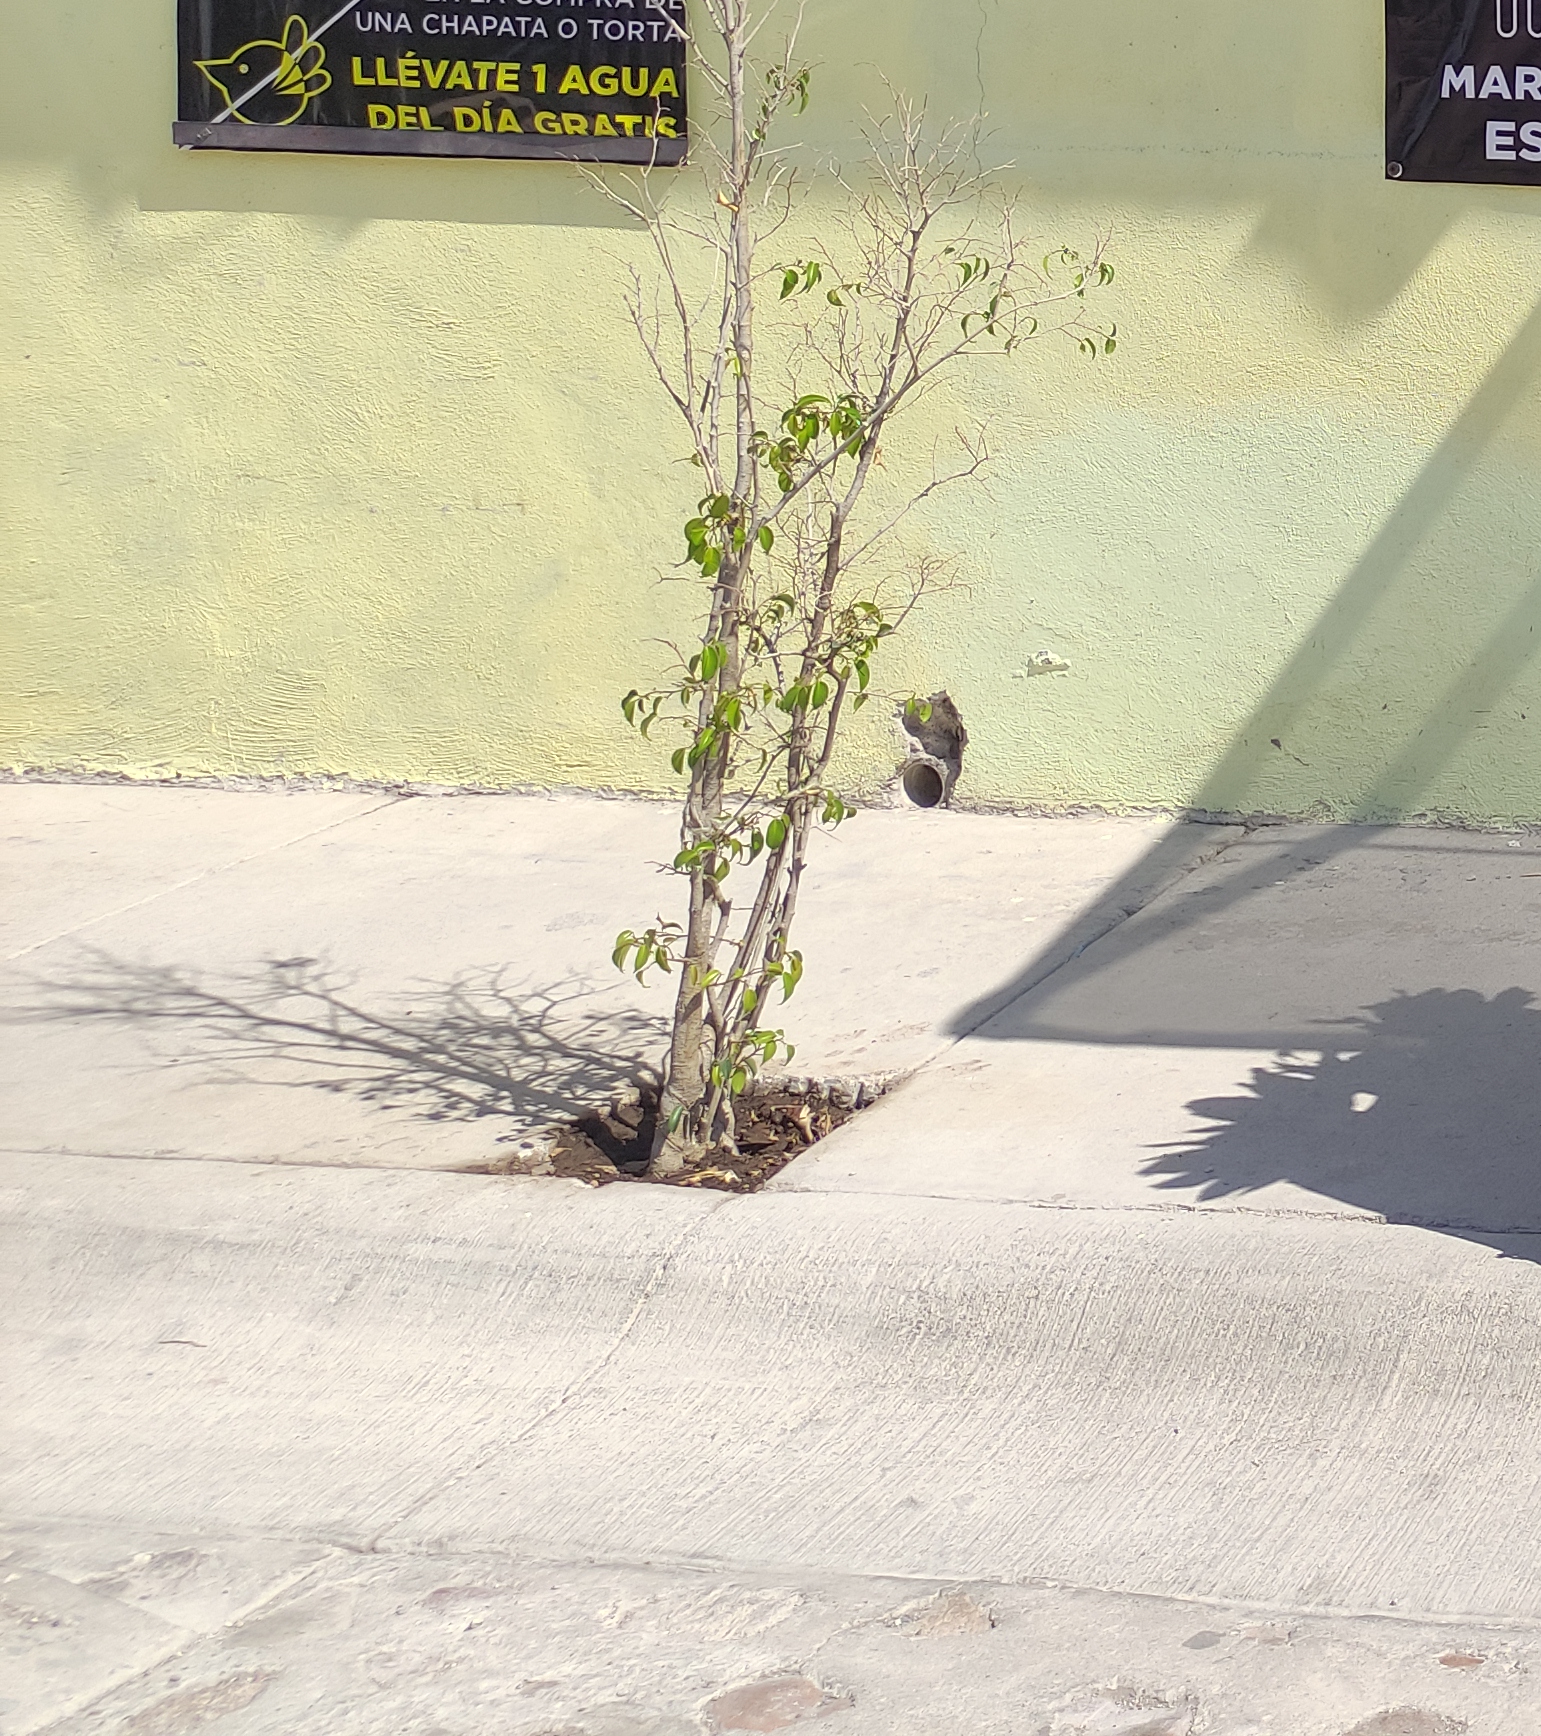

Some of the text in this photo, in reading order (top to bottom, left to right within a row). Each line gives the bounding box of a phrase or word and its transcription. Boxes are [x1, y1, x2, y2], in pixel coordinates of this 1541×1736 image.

[355, 11, 685, 42] UNA CHAPATA O TORTA
[351, 51, 680, 97] LLÉVATE 1 AGUA
[367, 101, 678, 138] DEL DÍA GRATIS
